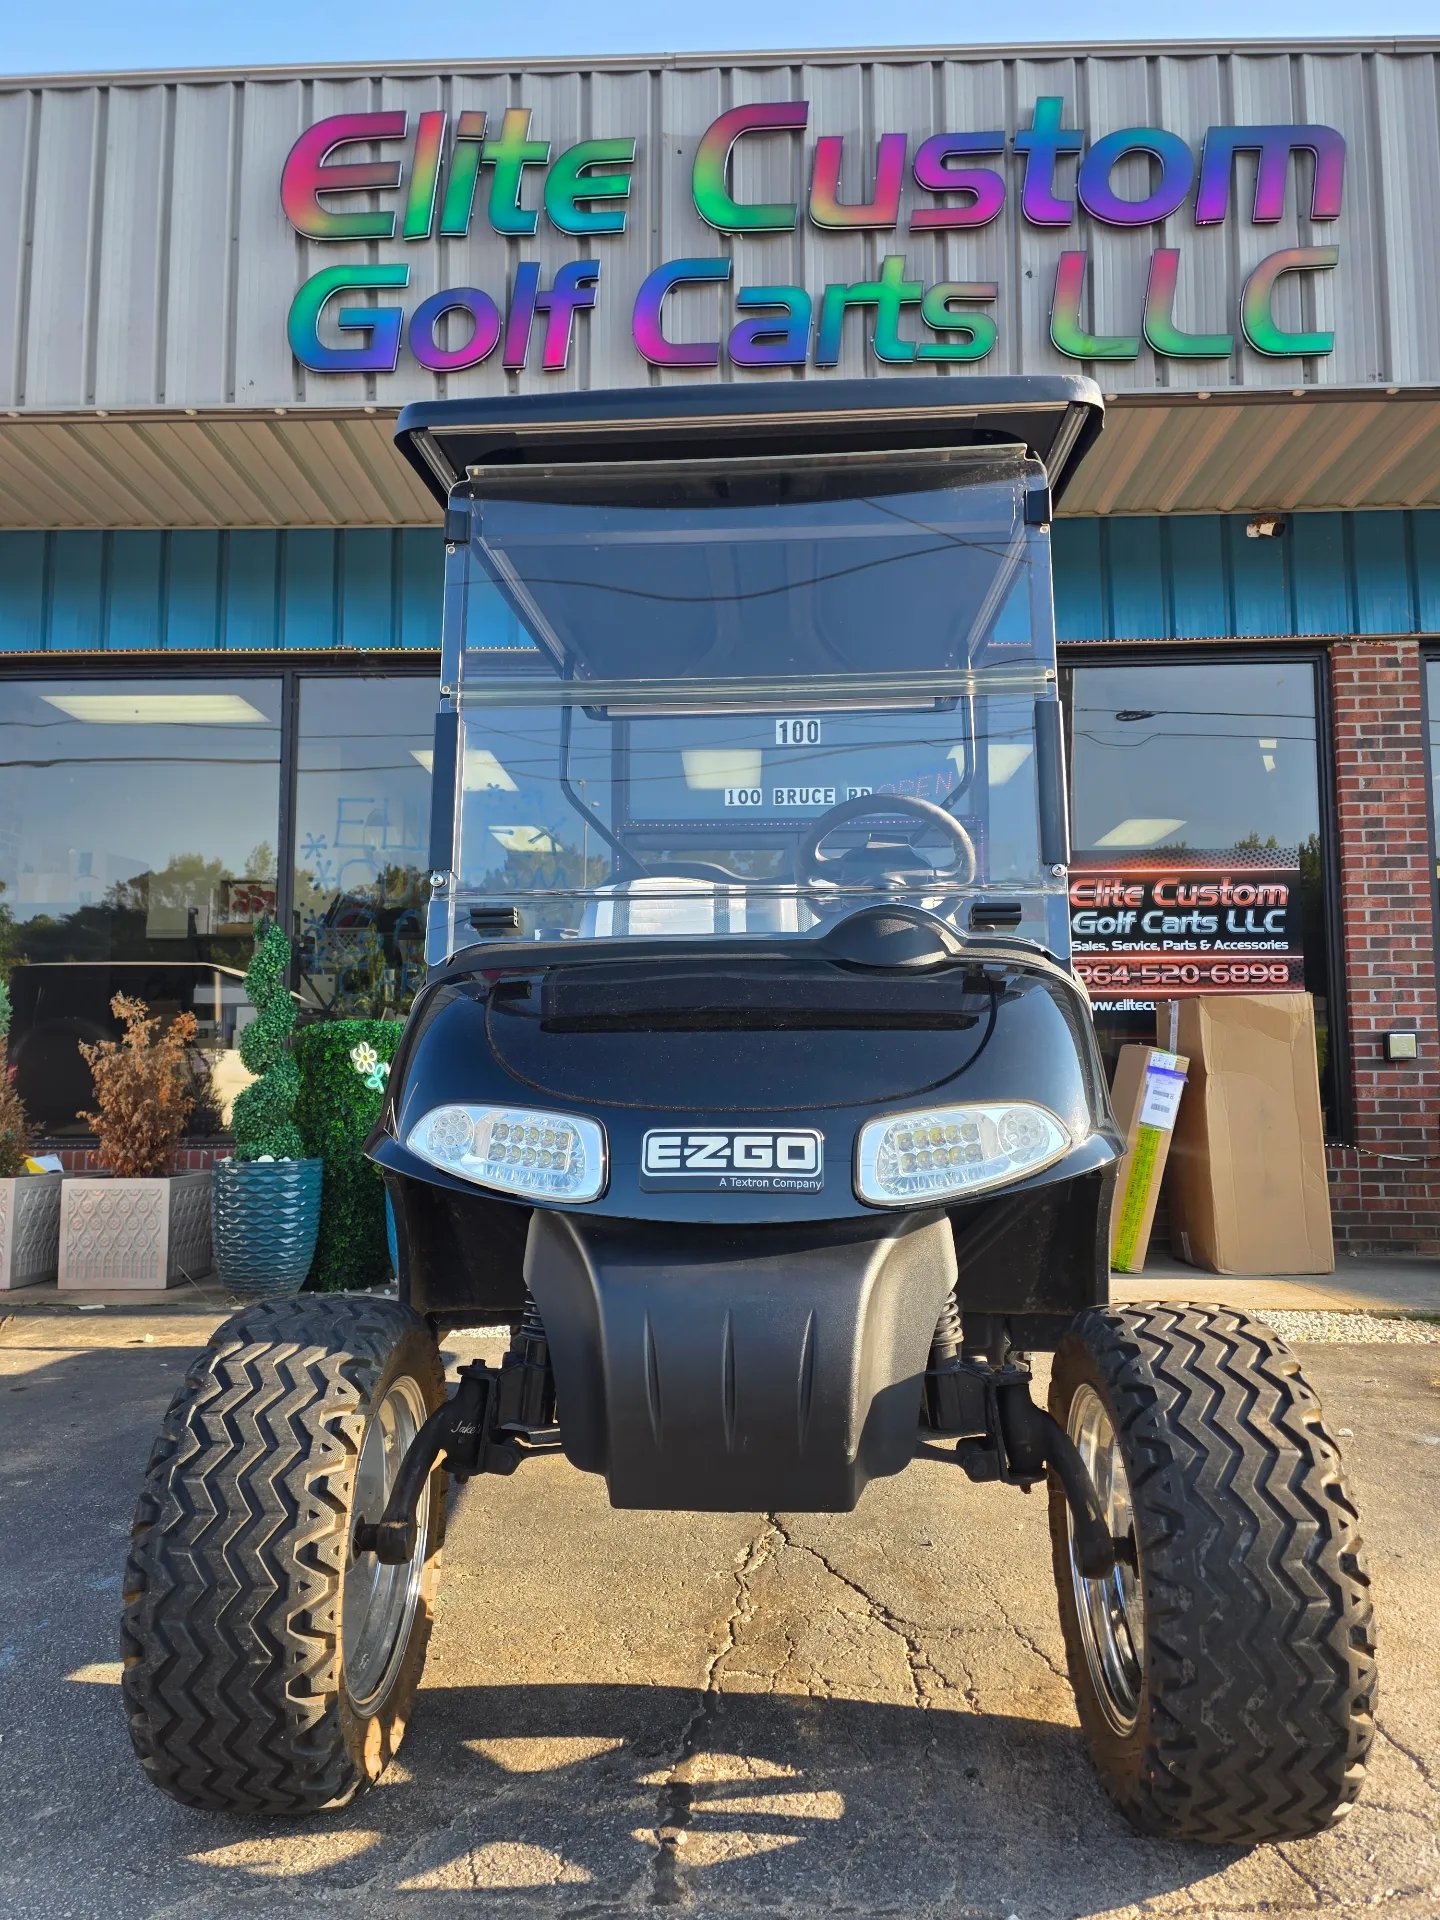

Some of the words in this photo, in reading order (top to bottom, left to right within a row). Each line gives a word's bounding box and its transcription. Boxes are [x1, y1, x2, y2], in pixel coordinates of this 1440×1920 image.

[280, 107, 637, 241] Elite
[692, 96, 1347, 234] Custom
[287, 258, 601, 373] Golf
[631, 254, 1000, 370] Carts
[1049, 244, 1340, 360] LLC
[778, 720, 819, 744] 100
[727, 789, 761, 805] 100
[774, 788, 834, 804] BRUCE
[1069, 878, 1144, 908] Elite
[1152, 876, 1289, 907] Custom
[1071, 909, 1137, 935] Golf
[1141, 909, 1219, 935] Carts
[1226, 908, 1287, 934] LLC
[1072, 940, 1109, 952] Sales,
[1111, 940, 1161, 951] Service,
[1163, 940, 1197, 951] Parts
[1200, 940, 1211, 950] &
[1213, 939, 1289, 950] Accessories
[1075, 964, 1289, 985] 864-520-6898
[1090, 998, 1171, 1011] ww.elitecu
[719, 1178, 727, 1187] A
[730, 1178, 769, 1188] Textron
[772, 1178, 822, 1190] Company
